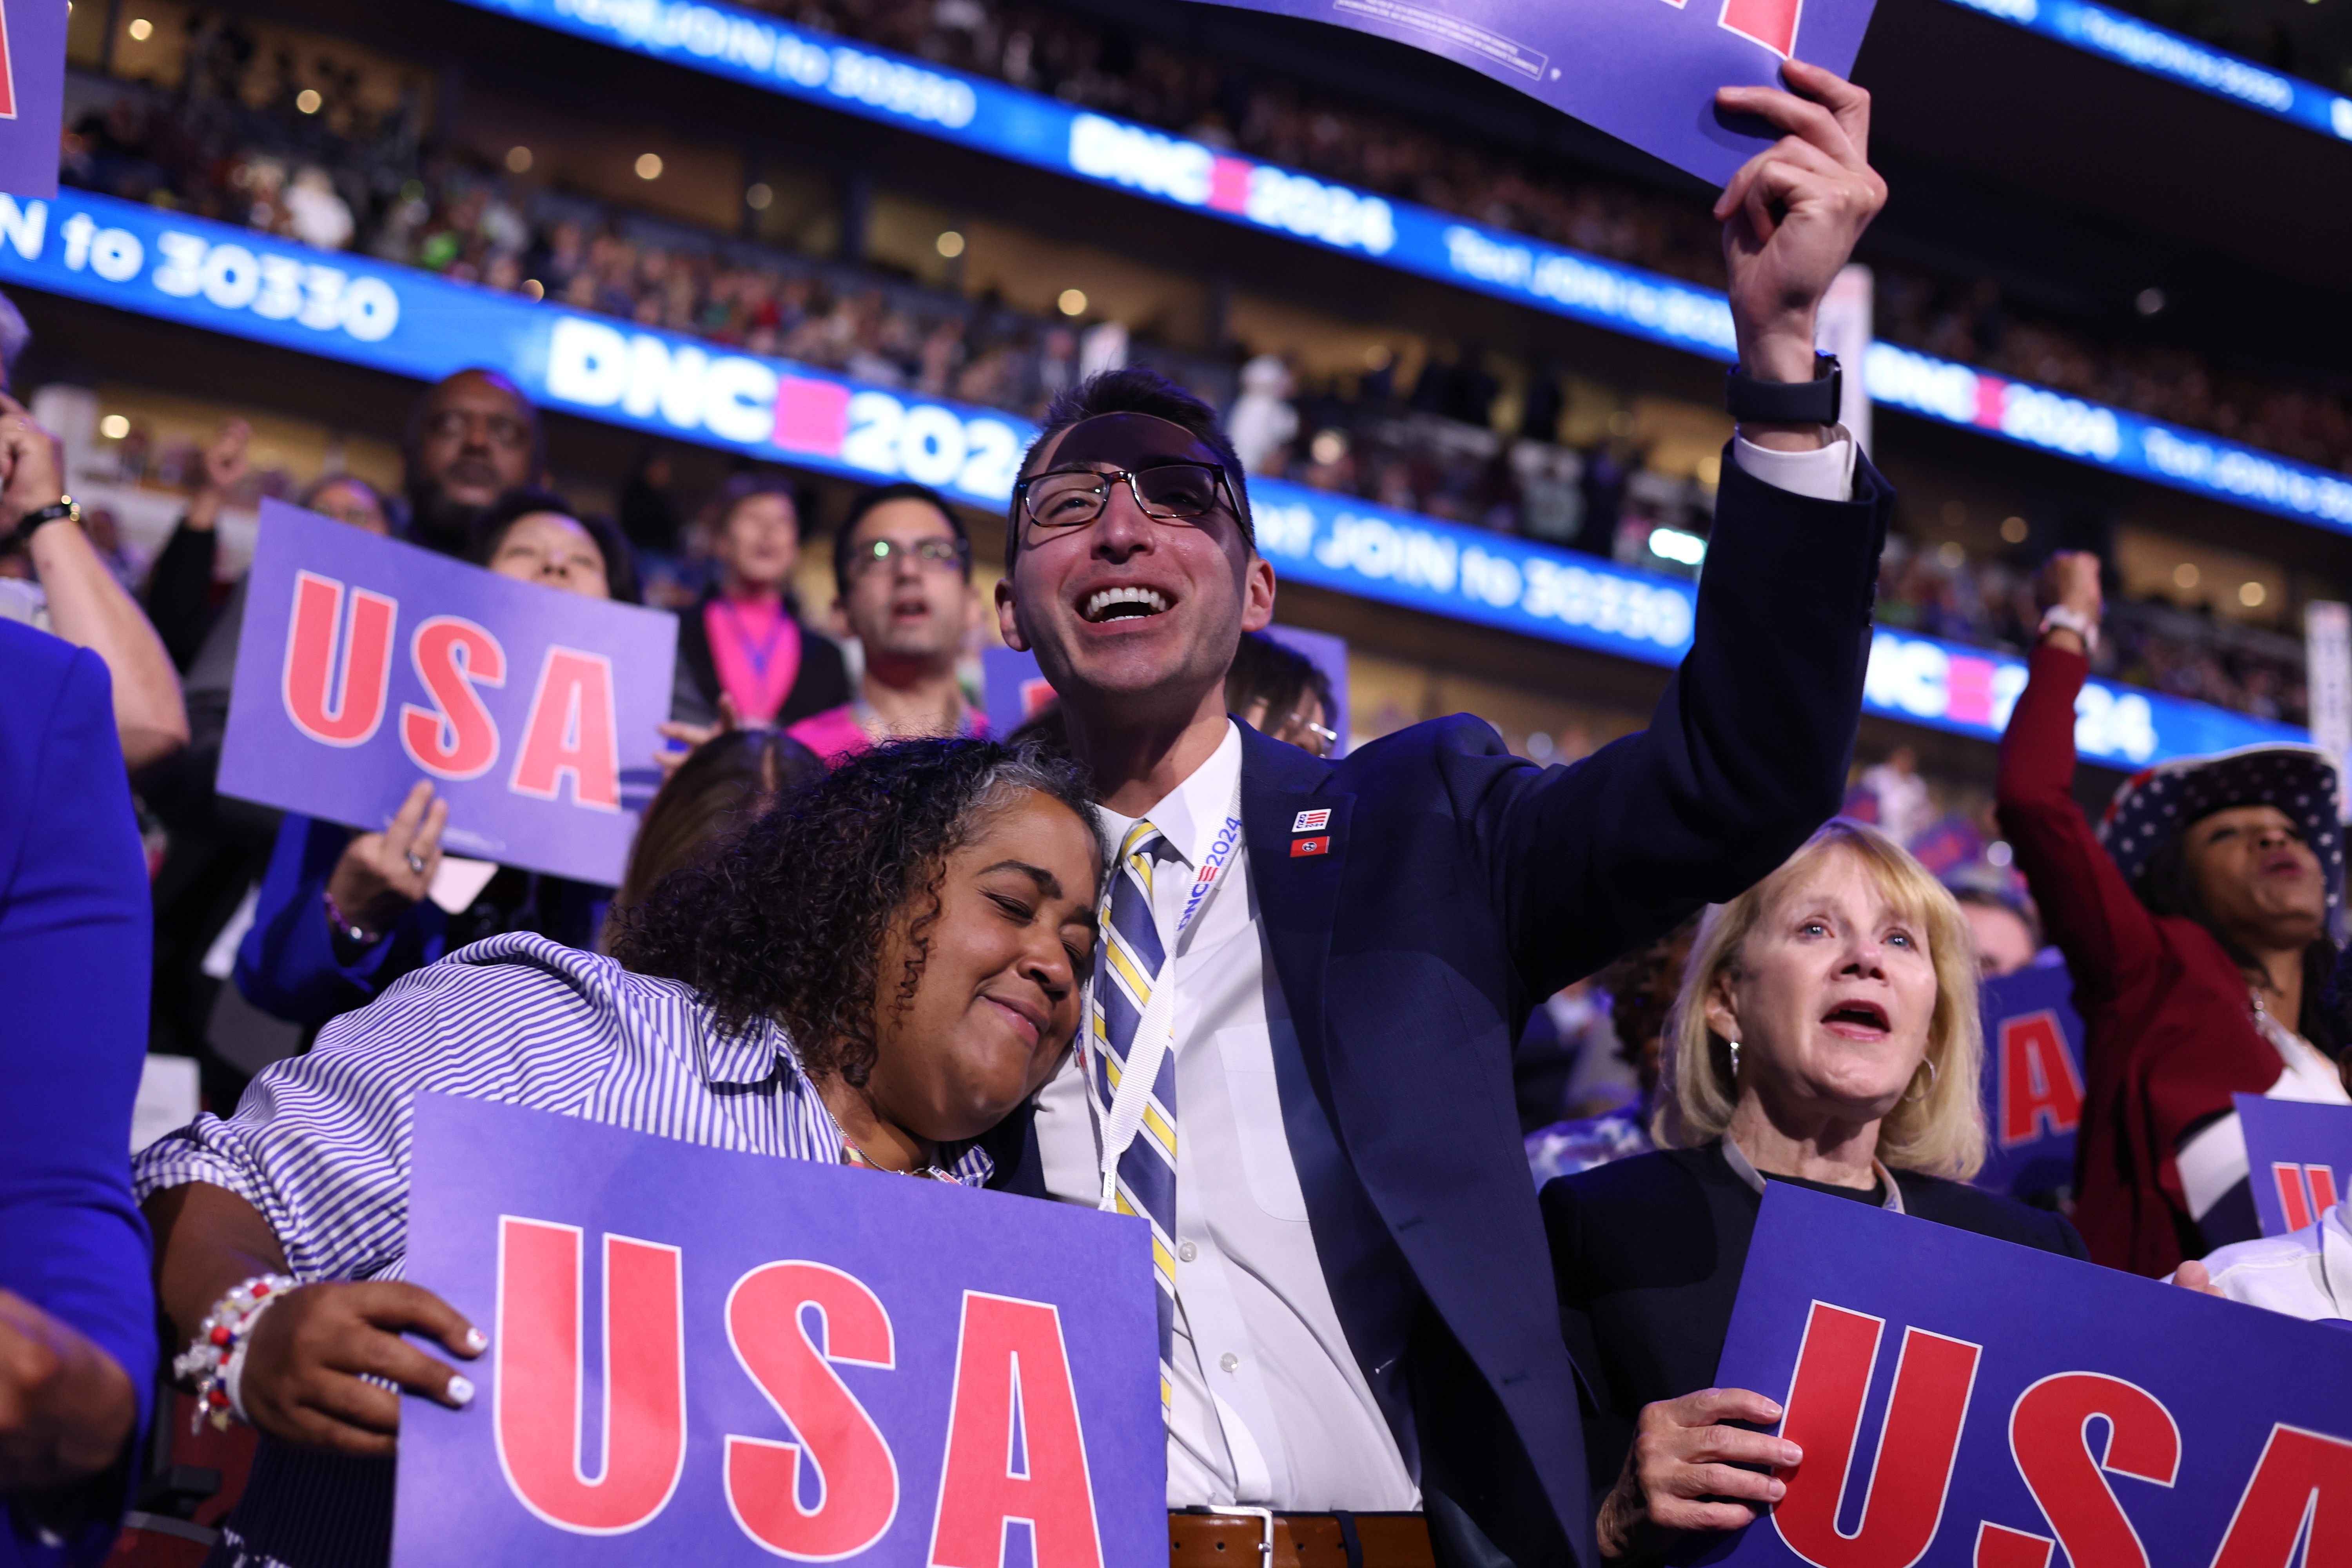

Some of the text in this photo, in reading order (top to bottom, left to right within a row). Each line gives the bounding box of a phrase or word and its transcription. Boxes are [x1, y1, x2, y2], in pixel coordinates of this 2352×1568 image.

[1069, 114, 1216, 204] DNC
[1243, 167, 1395, 254] 2024
[62, 212, 144, 281] to
[153, 230, 400, 342] 30330
[547, 316, 1025, 501] DNC 202
[281, 568, 622, 815] USA
[1863, 634, 2157, 762] NC 224
[1206, 816, 1242, 867] 2024
[492, 1213, 1105, 1568] USA
